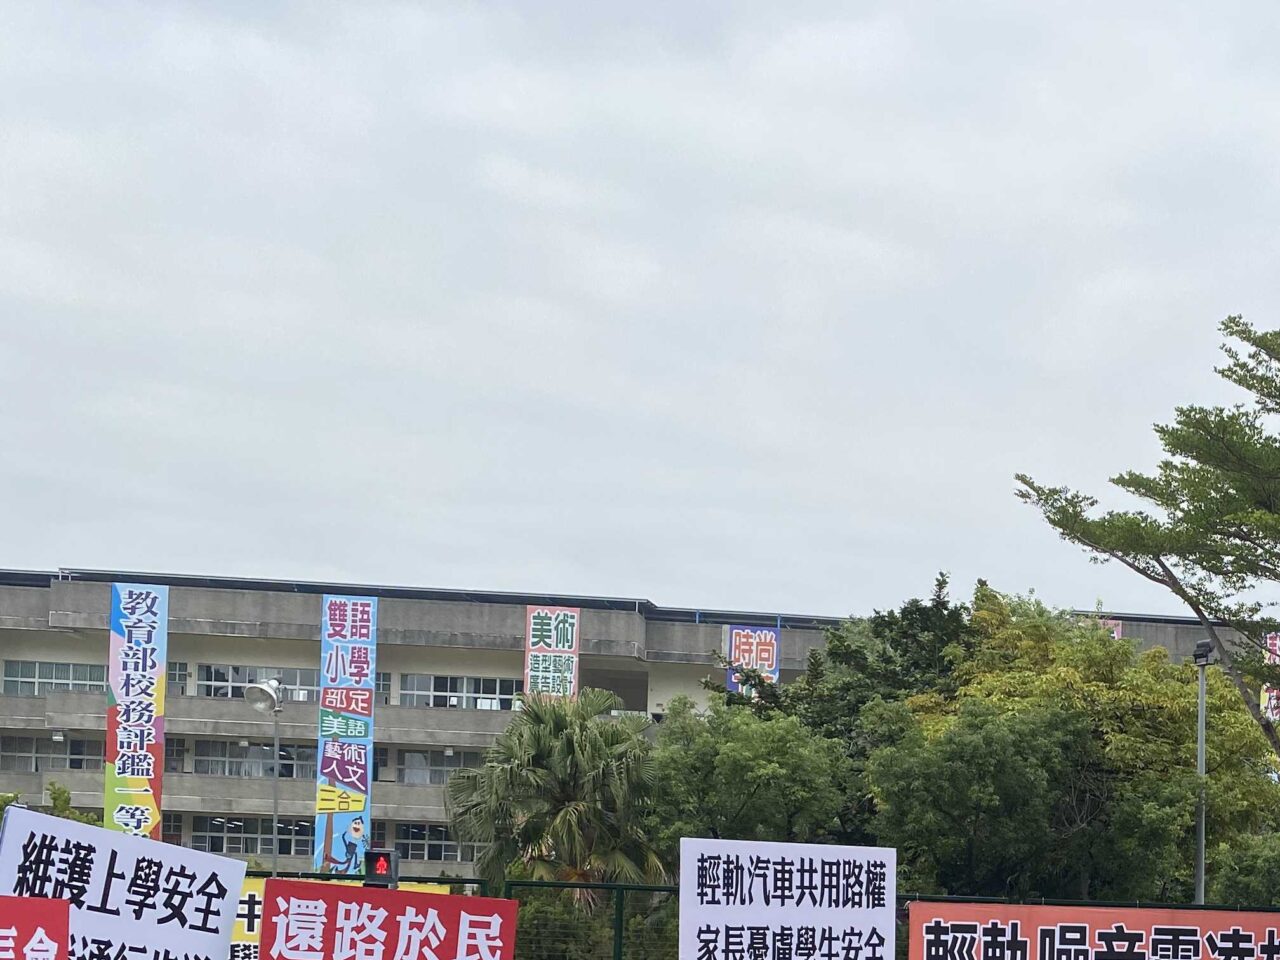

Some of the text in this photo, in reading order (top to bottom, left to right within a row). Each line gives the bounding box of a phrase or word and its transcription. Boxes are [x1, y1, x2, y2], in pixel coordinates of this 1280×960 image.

[326, 600, 372, 641] 雙語
[530, 610, 577, 650] 美術
[325, 645, 370, 684] 小學
[529, 653, 575, 676] 造型藝術
[732, 630, 776, 670] 時尚
[113, 588, 160, 838] 教育部校務評鑑一等
[325, 688, 369, 715] 部定
[321, 715, 365, 737] 美語
[325, 741, 366, 765] 藝術
[323, 760, 366, 791] 人文
[320, 789, 363, 811] 三合一
[13, 831, 228, 934] 維護上學安全
[696, 853, 887, 909] 輕軌汽車共用路權
